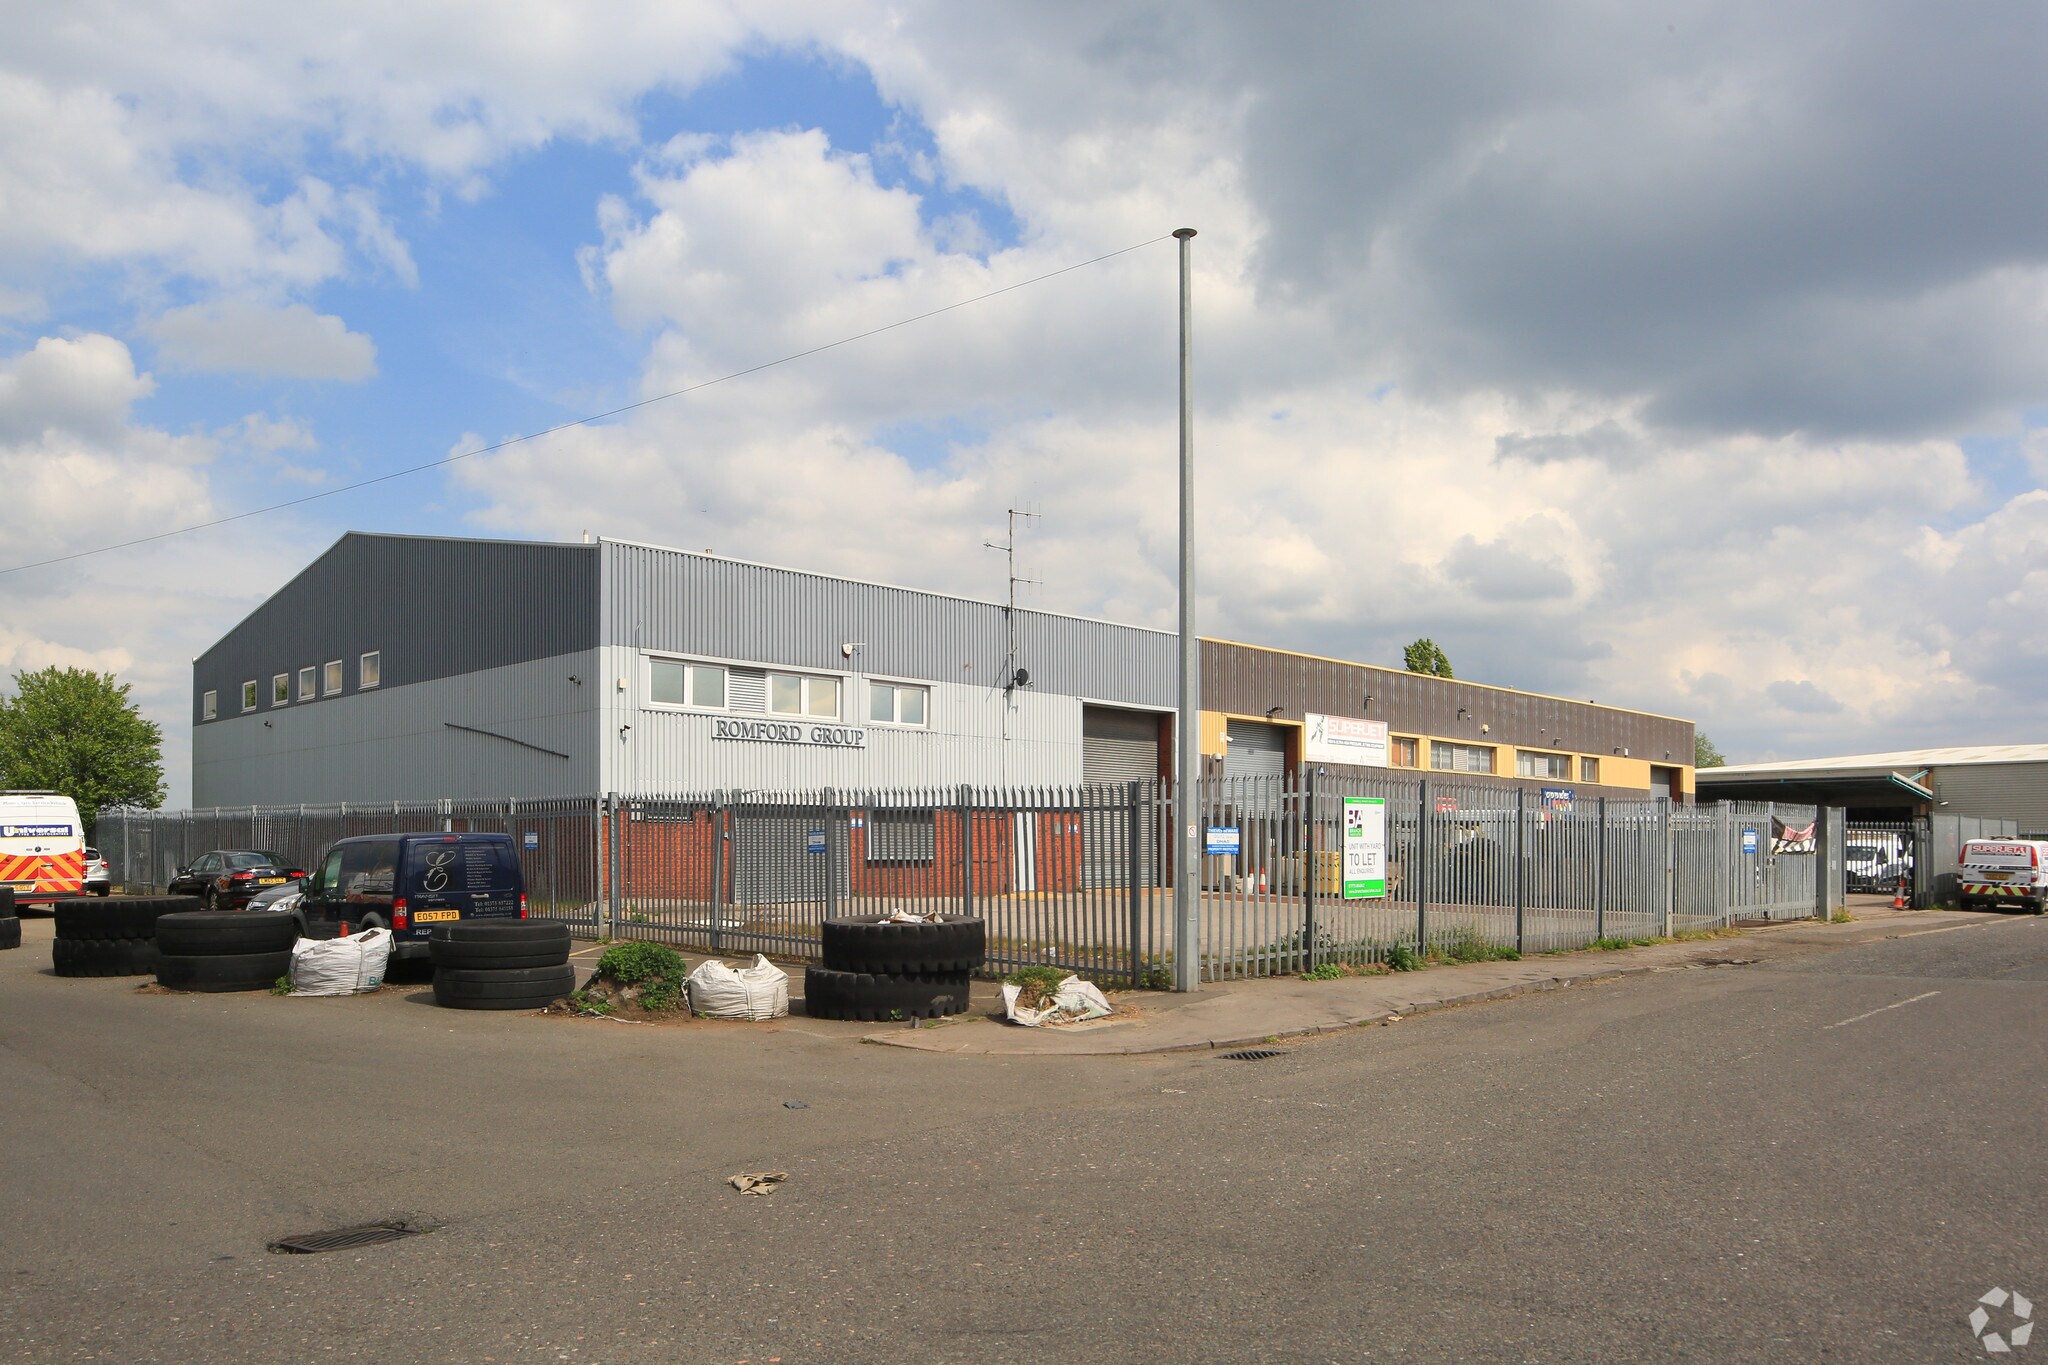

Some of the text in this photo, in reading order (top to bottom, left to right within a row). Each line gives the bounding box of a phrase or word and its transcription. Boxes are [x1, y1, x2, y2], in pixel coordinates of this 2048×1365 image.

[716, 720, 865, 746] ROMFORD GROUP
[1328, 719, 1384, 737] SUPERJET
[4, 826, 69, 837] Universal
[1349, 853, 1377, 867] TO LET
[417, 911, 457, 921] EO57 FPD
